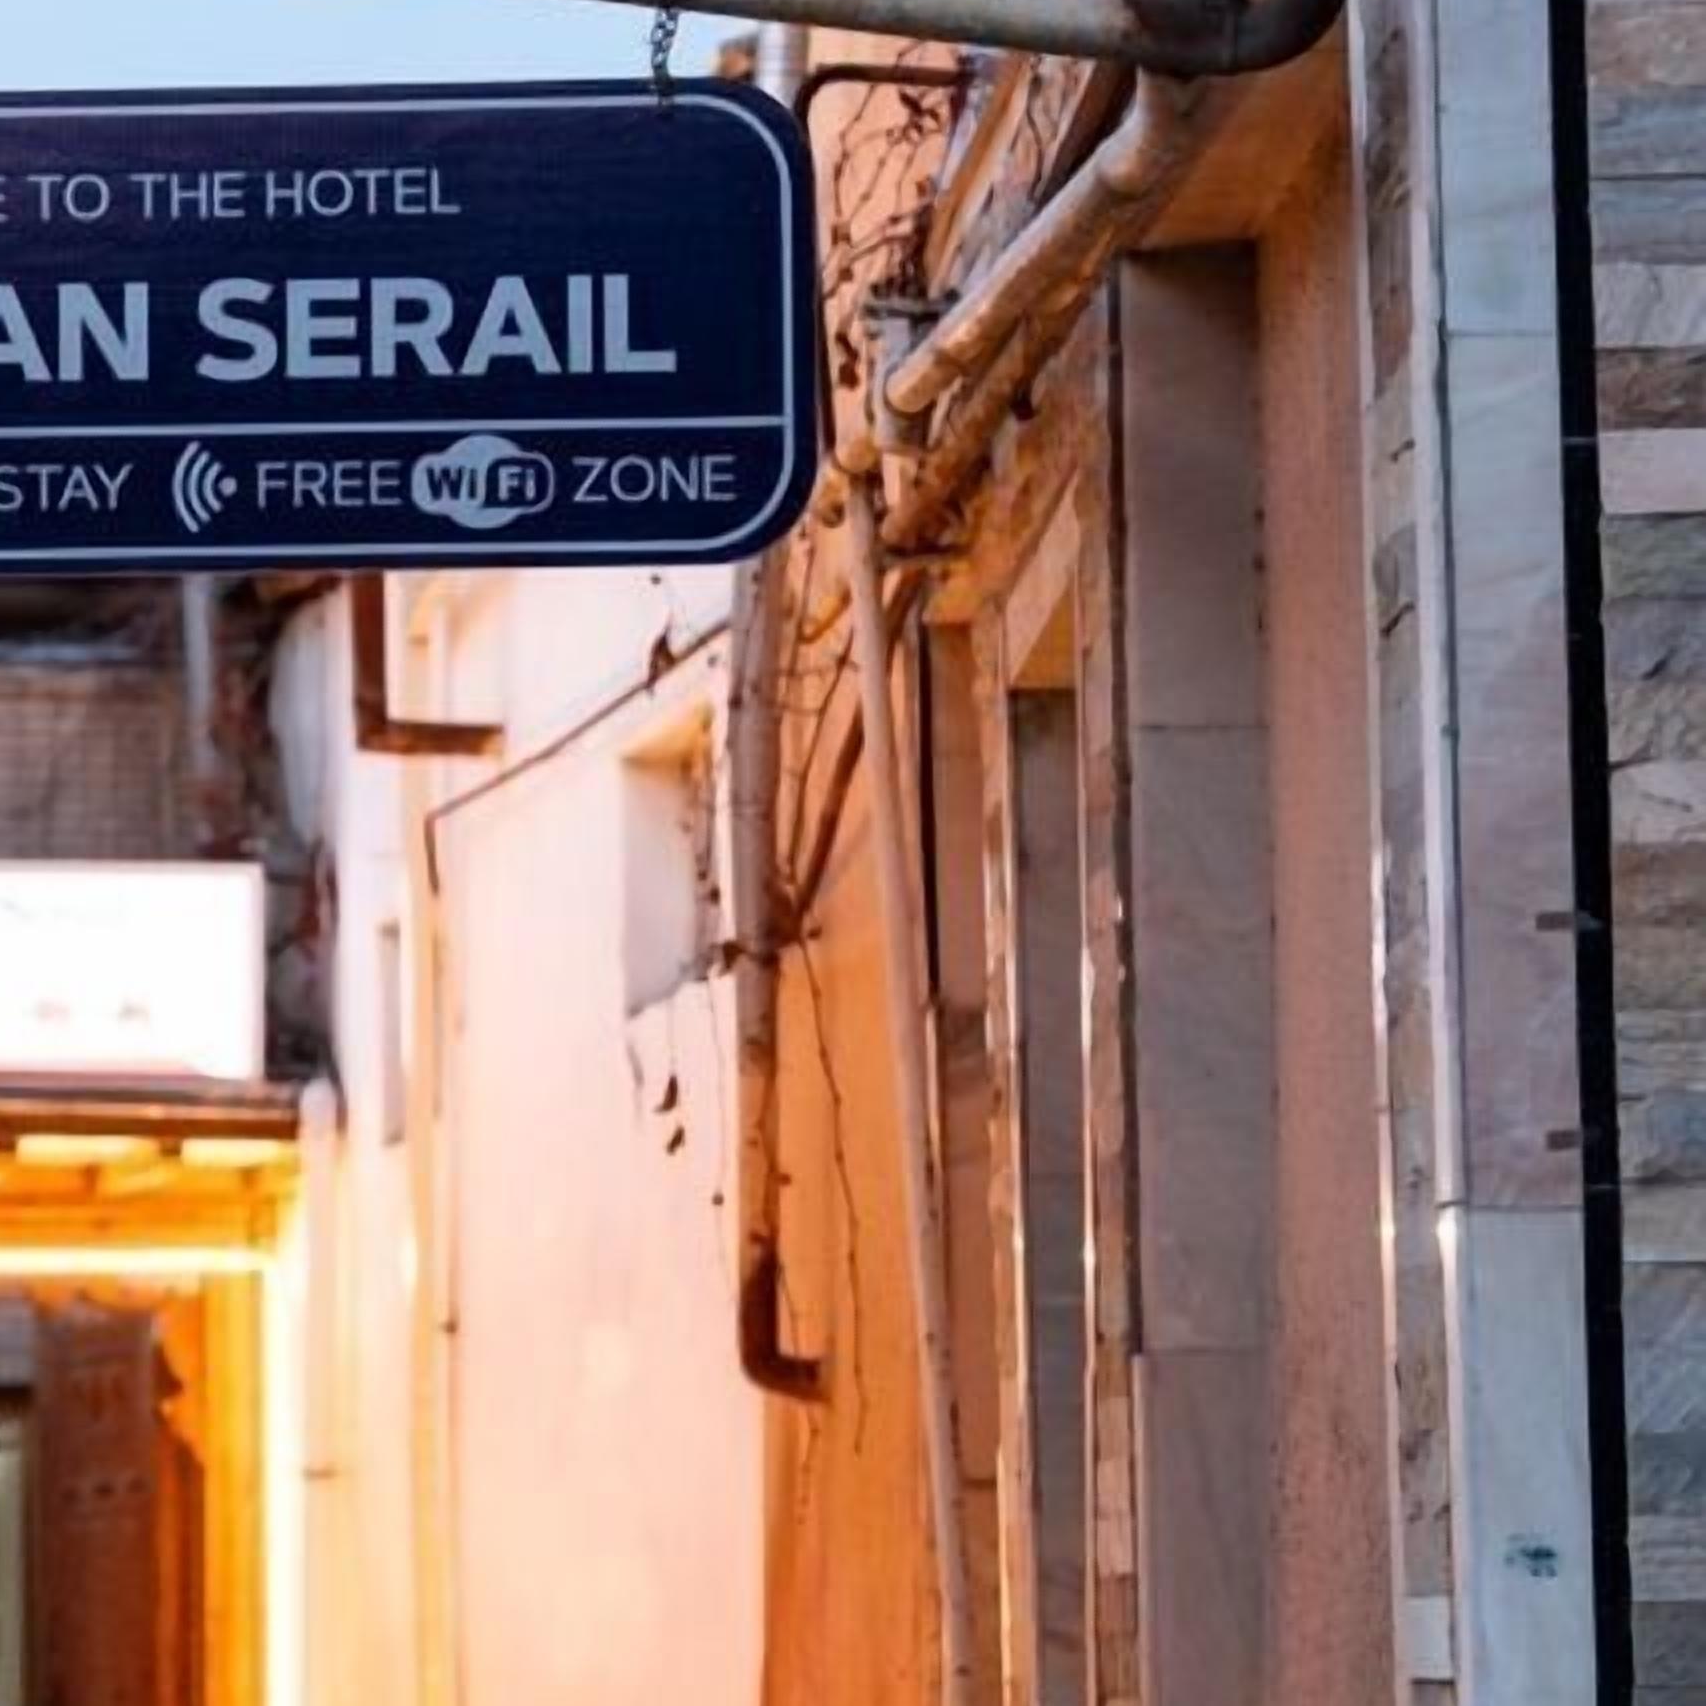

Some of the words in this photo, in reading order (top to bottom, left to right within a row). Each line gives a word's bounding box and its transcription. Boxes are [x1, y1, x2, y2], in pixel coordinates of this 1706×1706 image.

[27, 174, 111, 220] TO
[130, 172, 246, 219] THE
[266, 167, 460, 217] HOTEL
[197, 274, 676, 381] SERAIL
[257, 459, 402, 506] FREE
[572, 454, 737, 502] ZONE
